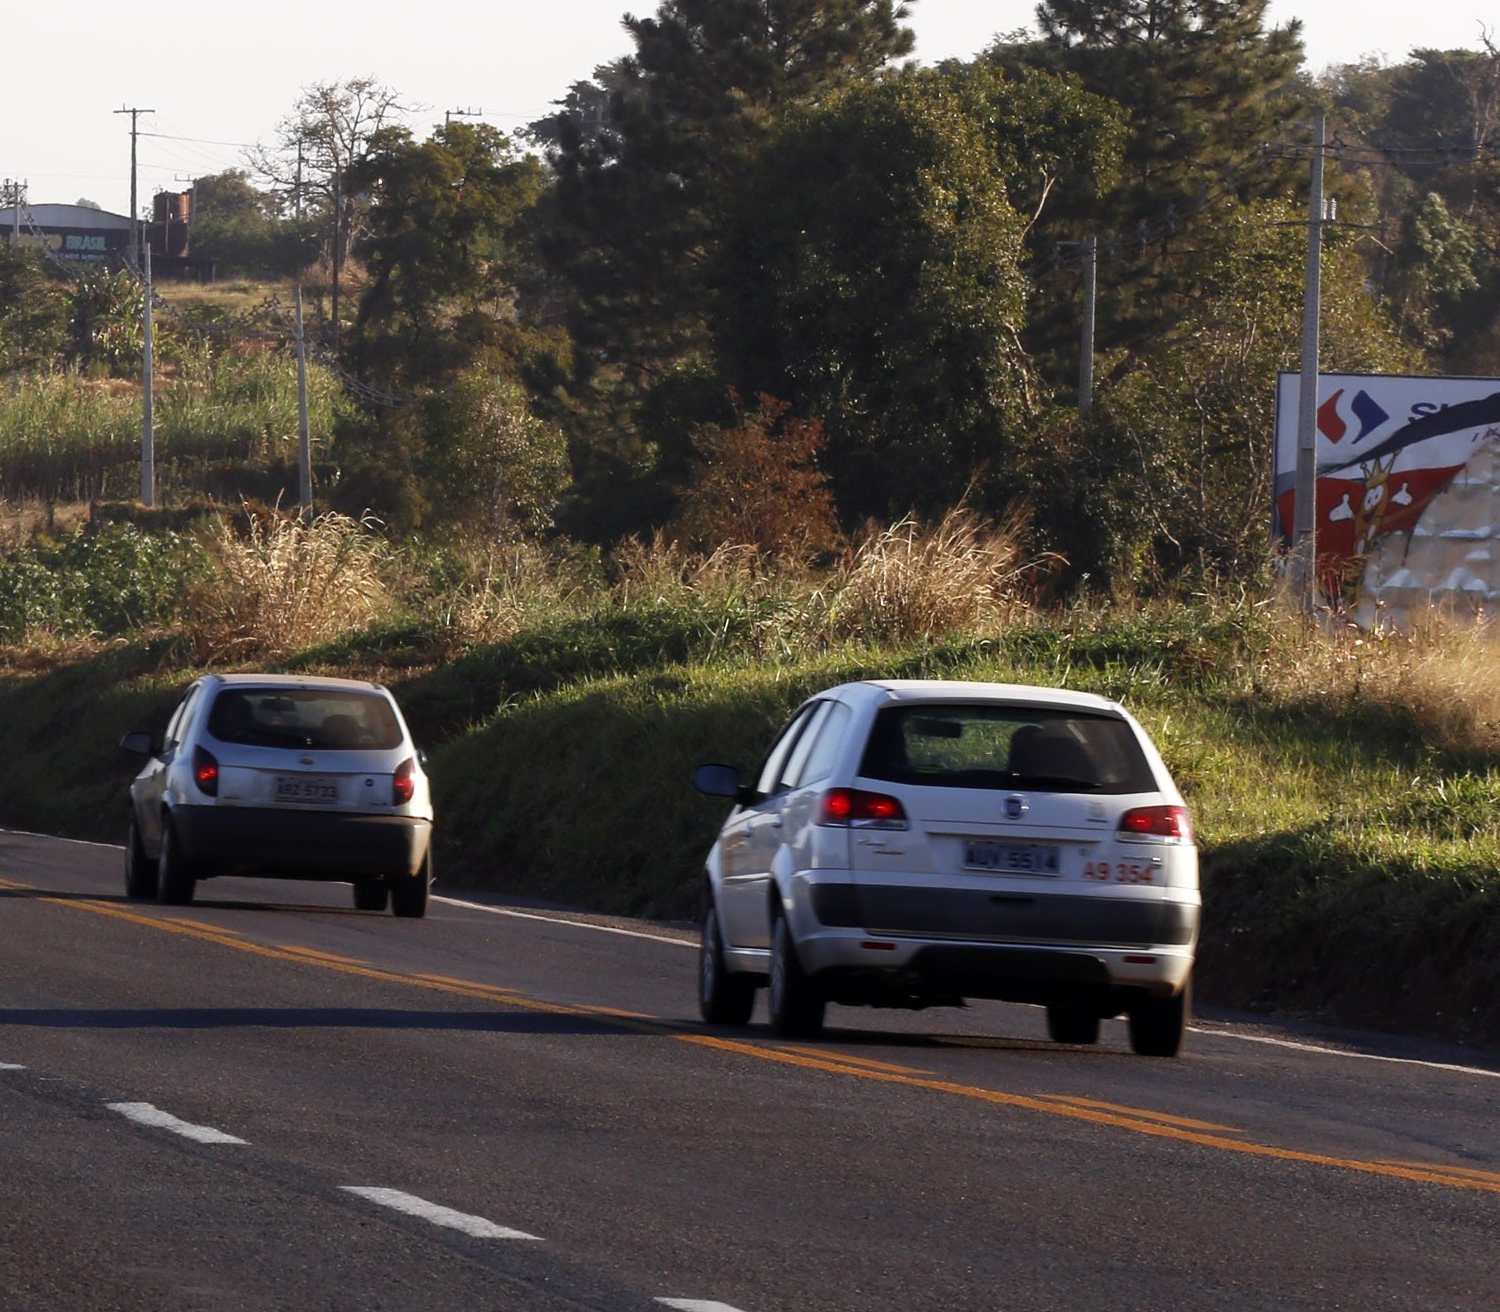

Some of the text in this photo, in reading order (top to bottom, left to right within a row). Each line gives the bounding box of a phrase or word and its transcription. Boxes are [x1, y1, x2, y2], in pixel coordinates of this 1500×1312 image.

[65, 234, 107, 251] BRASIL
[1082, 861, 1155, 884] A9 354
